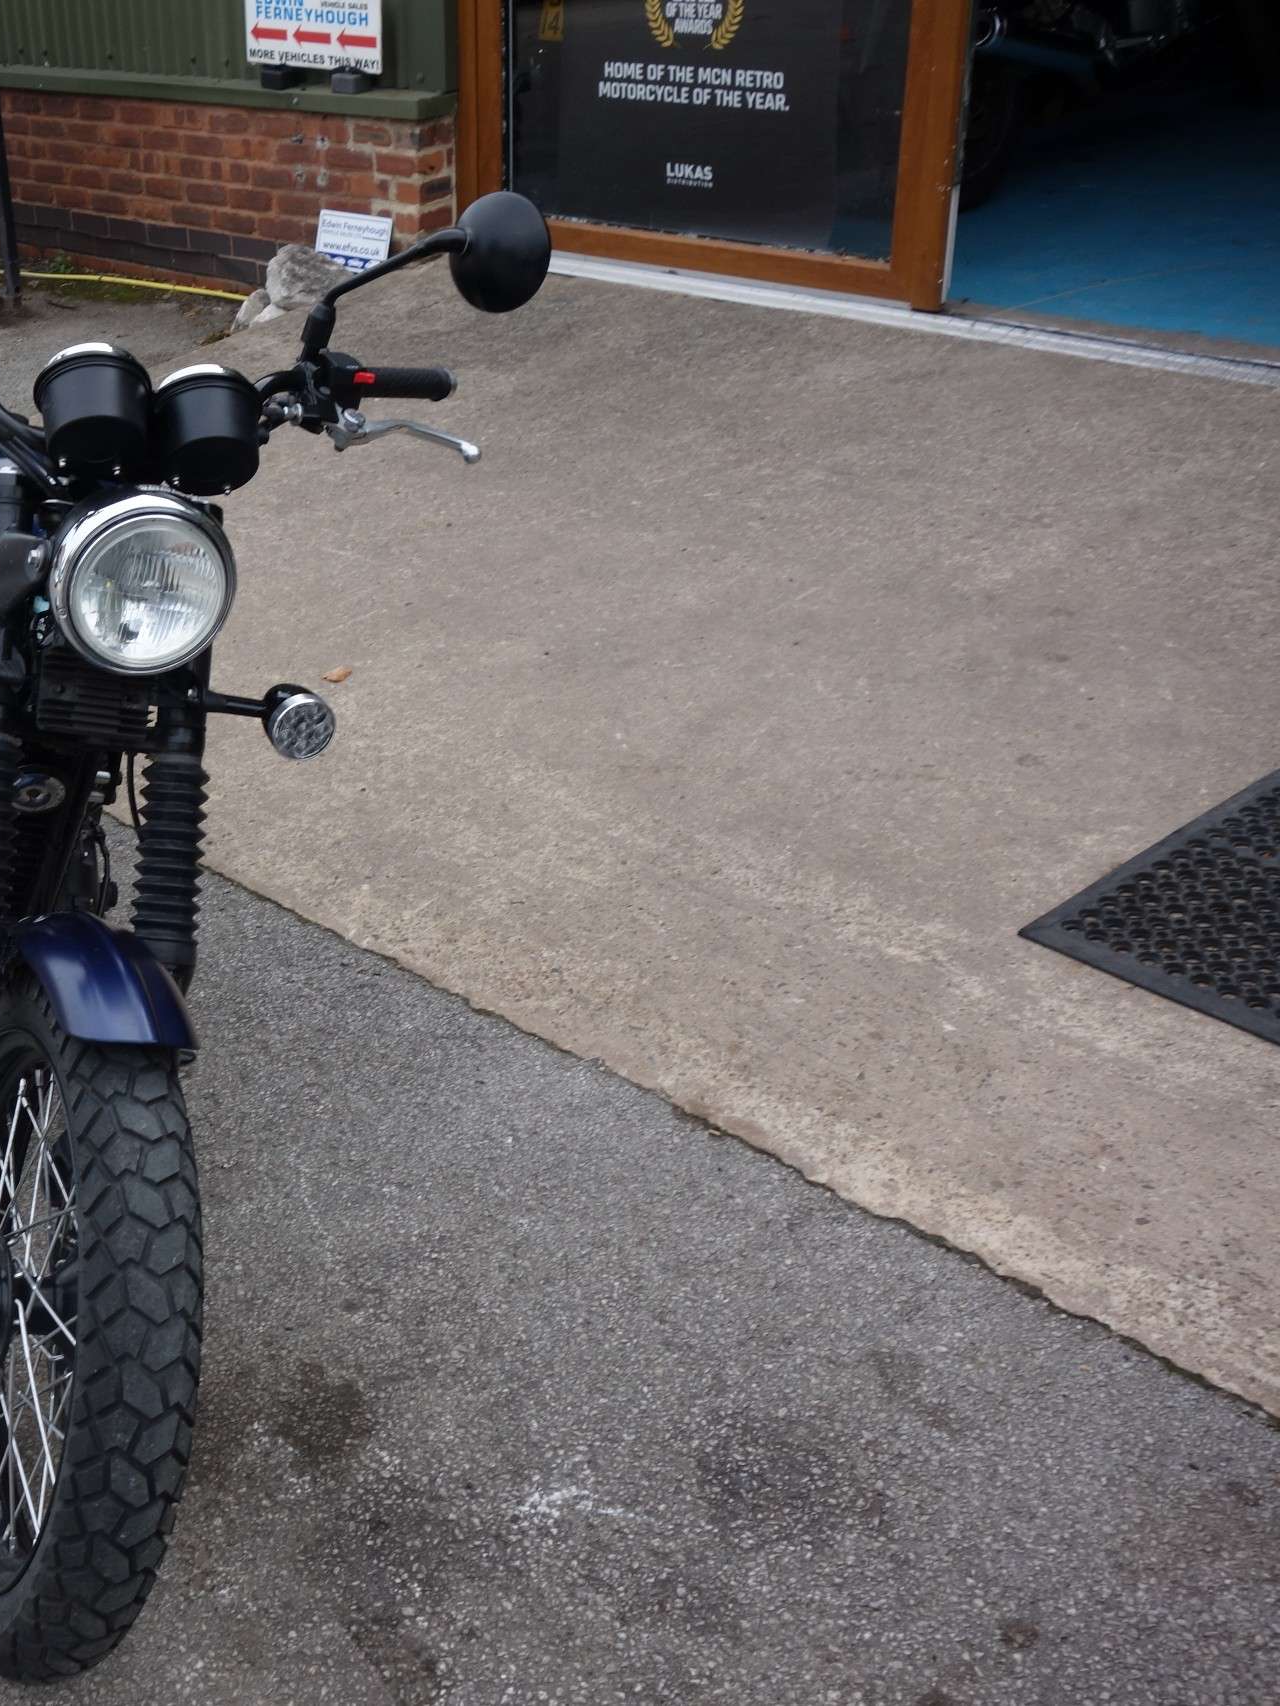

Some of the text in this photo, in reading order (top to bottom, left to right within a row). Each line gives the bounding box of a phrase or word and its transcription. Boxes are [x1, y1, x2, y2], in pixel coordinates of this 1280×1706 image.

[320, 1, 345, 9] VEHICLE
[666, 2, 722, 20] OF THE YEAR
[256, 6, 369, 26] FERNEYHOUGH
[673, 18, 714, 34] AWARDS
[249, 48, 276, 61] MORE
[278, 51, 325, 65] VEHICLES
[328, 55, 351, 67] THIS
[604, 61, 785, 90] HOME OF THE MCN RETRO
[598, 81, 790, 112] MOTORCYCLE OF THE YEAR.
[666, 162, 713, 181] LUKAS
